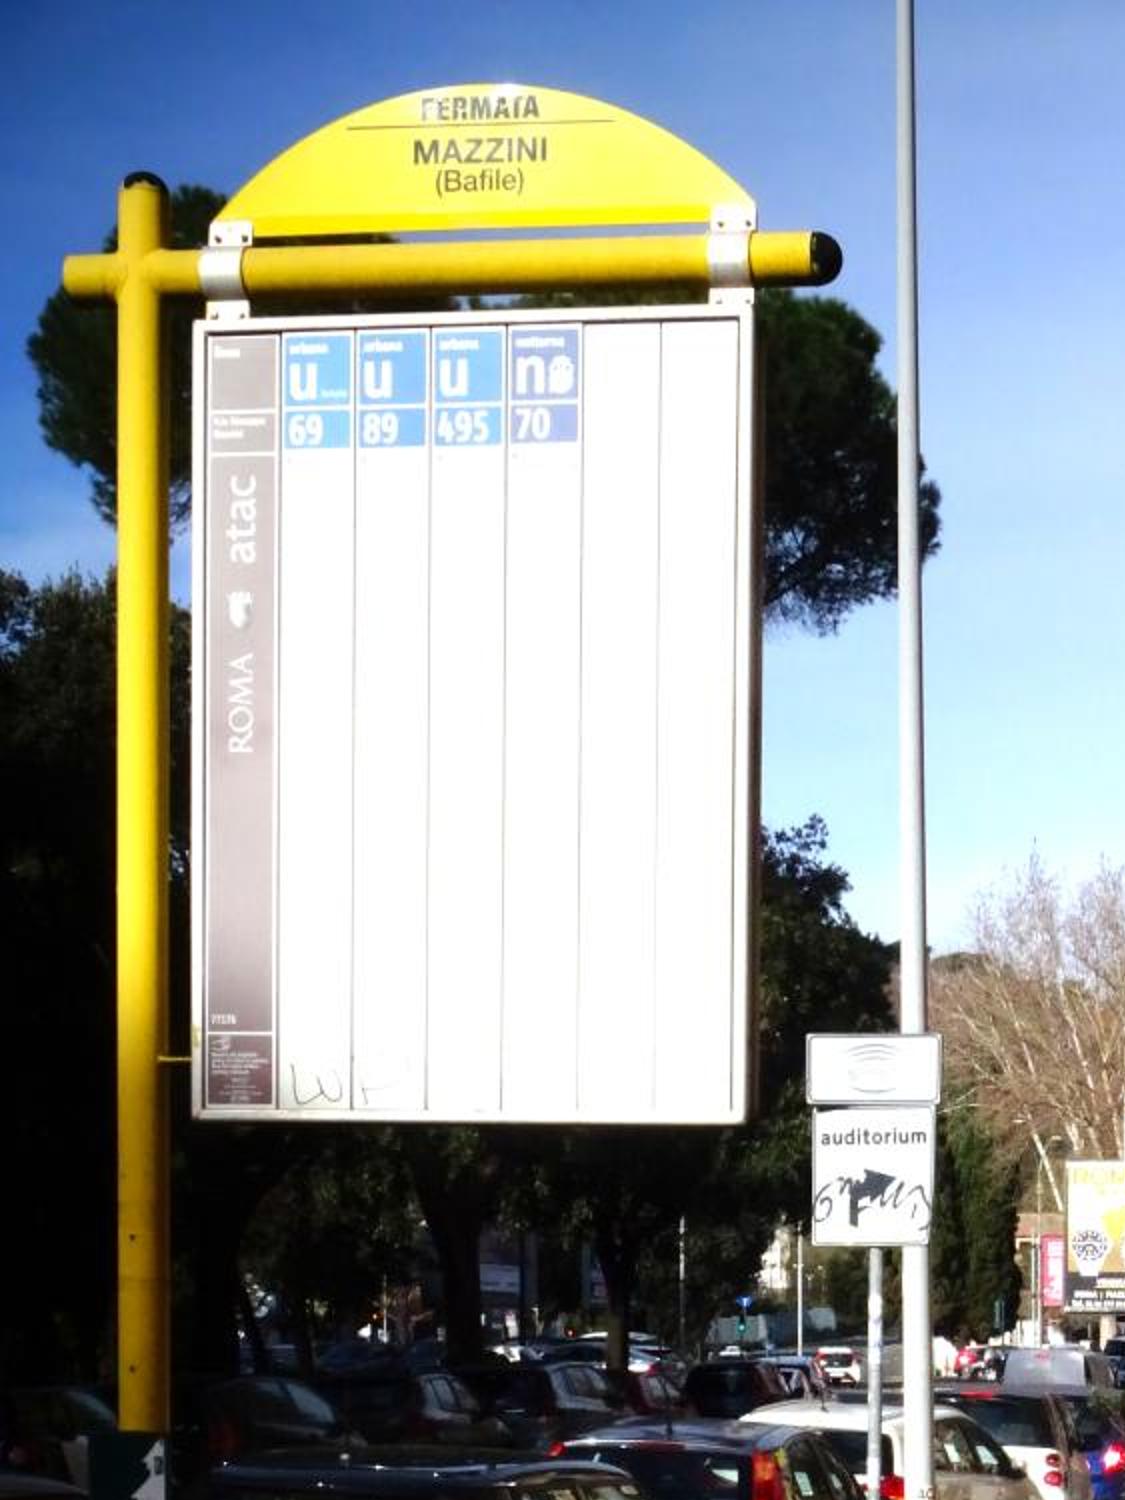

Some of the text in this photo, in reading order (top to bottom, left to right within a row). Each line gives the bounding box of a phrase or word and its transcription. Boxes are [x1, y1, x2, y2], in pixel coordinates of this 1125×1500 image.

[421, 95, 540, 121] FERMATA
[413, 138, 548, 165] MAZZINI
[435, 169, 526, 197] (Bafile)
[288, 414, 324, 446] 69
[362, 413, 399, 446] 89
[437, 410, 490, 443] 495
[514, 408, 551, 440] 70
[225, 474, 257, 564] atac
[227, 652, 254, 753] ROMA
[820, 1128, 927, 1146] auditorium
